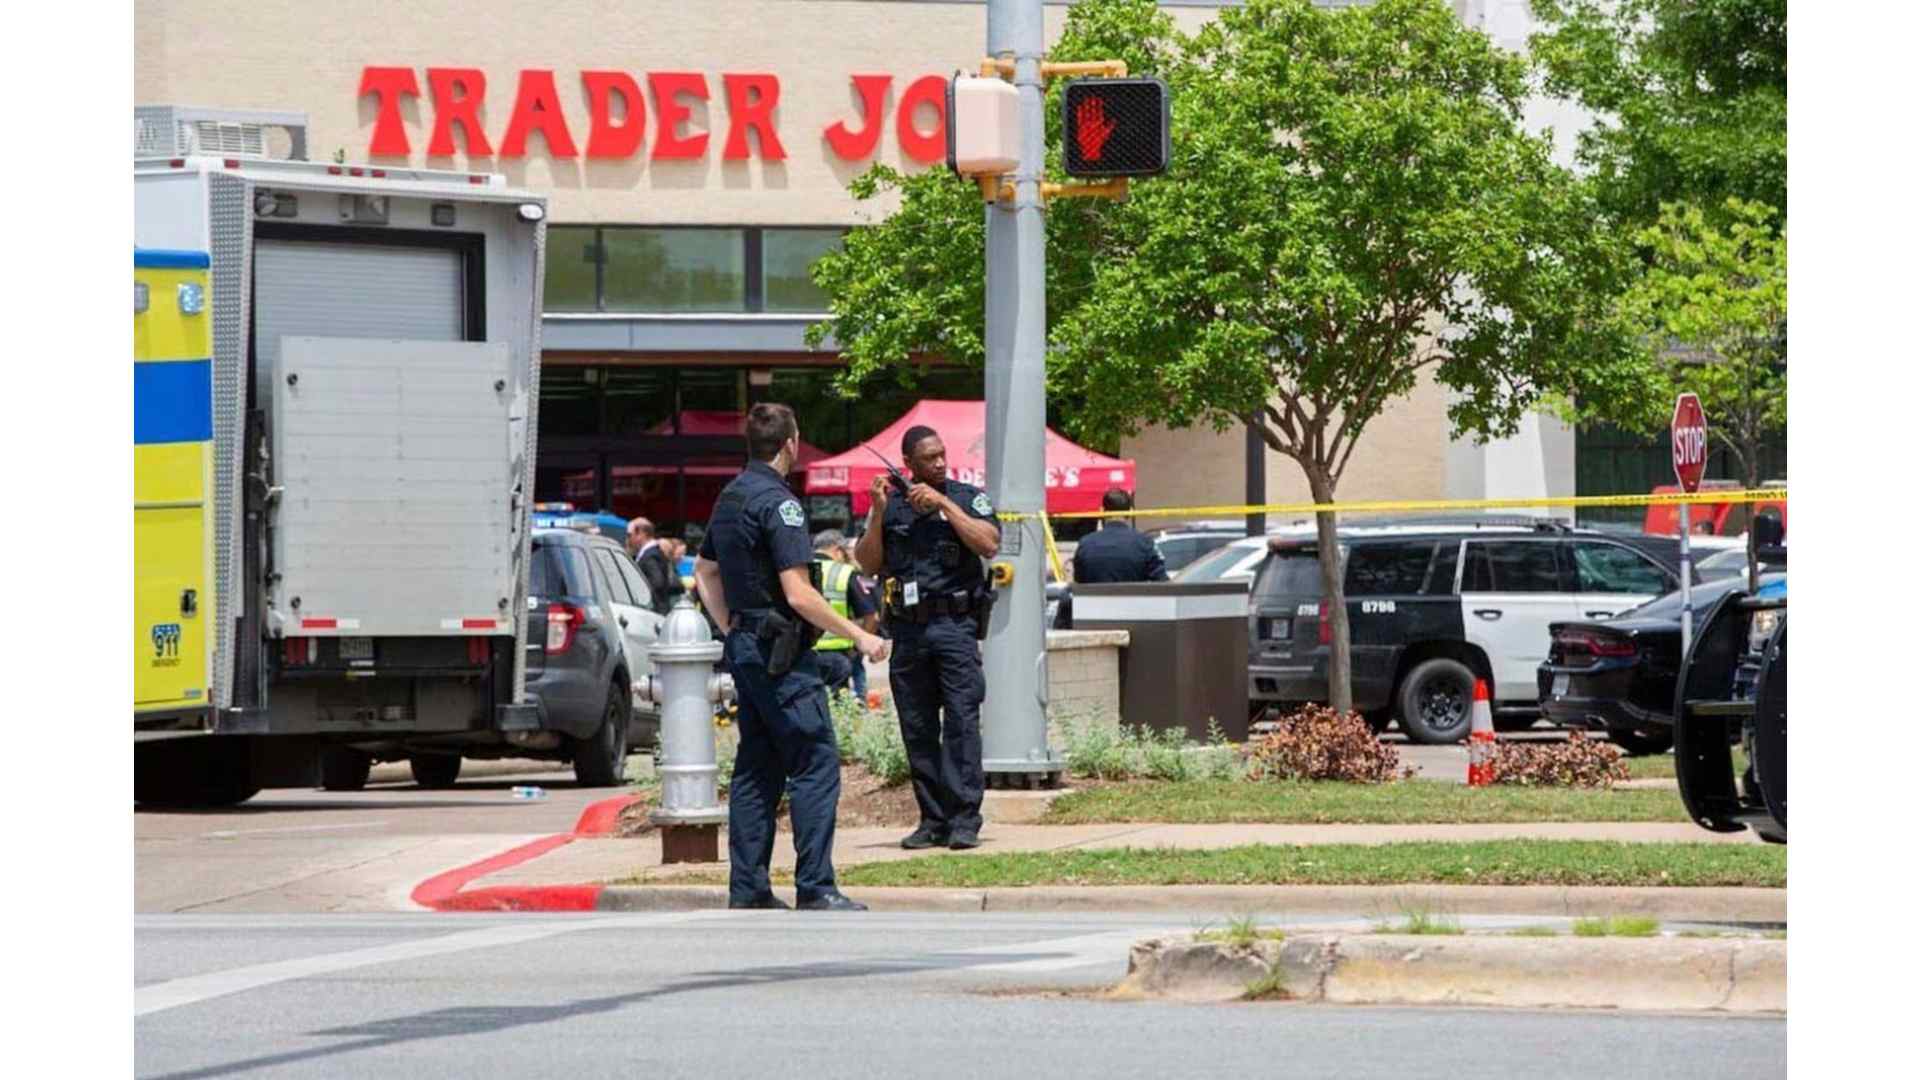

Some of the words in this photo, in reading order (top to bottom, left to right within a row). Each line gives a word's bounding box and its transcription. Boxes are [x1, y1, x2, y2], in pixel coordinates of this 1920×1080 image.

[358, 66, 787, 161] TRADER
[823, 75, 947, 163] JO
[1676, 427, 1705, 465] STOP
[1043, 465, 1079, 488] E'S
[154, 634, 179, 658] 911
